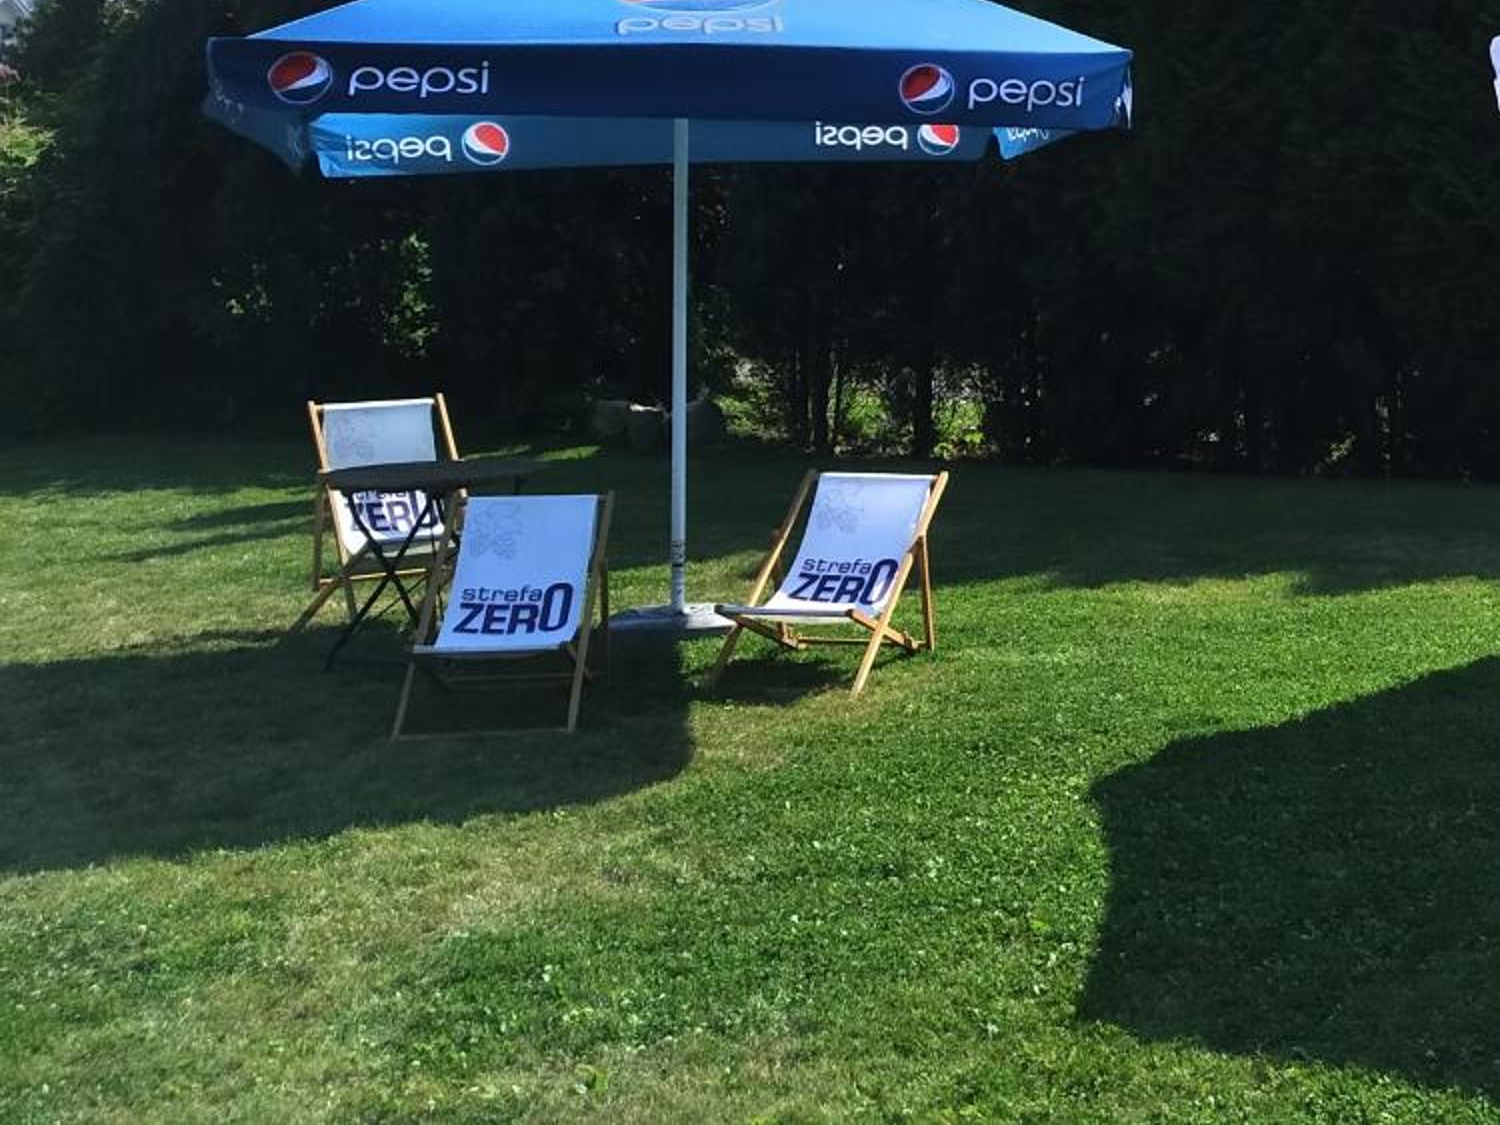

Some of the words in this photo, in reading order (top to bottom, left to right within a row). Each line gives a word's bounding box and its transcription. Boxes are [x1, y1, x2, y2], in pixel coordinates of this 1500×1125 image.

[616, 14, 784, 36] pepsi
[348, 60, 490, 98] pepsi
[967, 76, 1086, 112] pepsi
[788, 558, 899, 605] ZERO
[801, 558, 873, 574] strefa
[452, 582, 574, 636] ZERO
[462, 583, 543, 602] strefa
